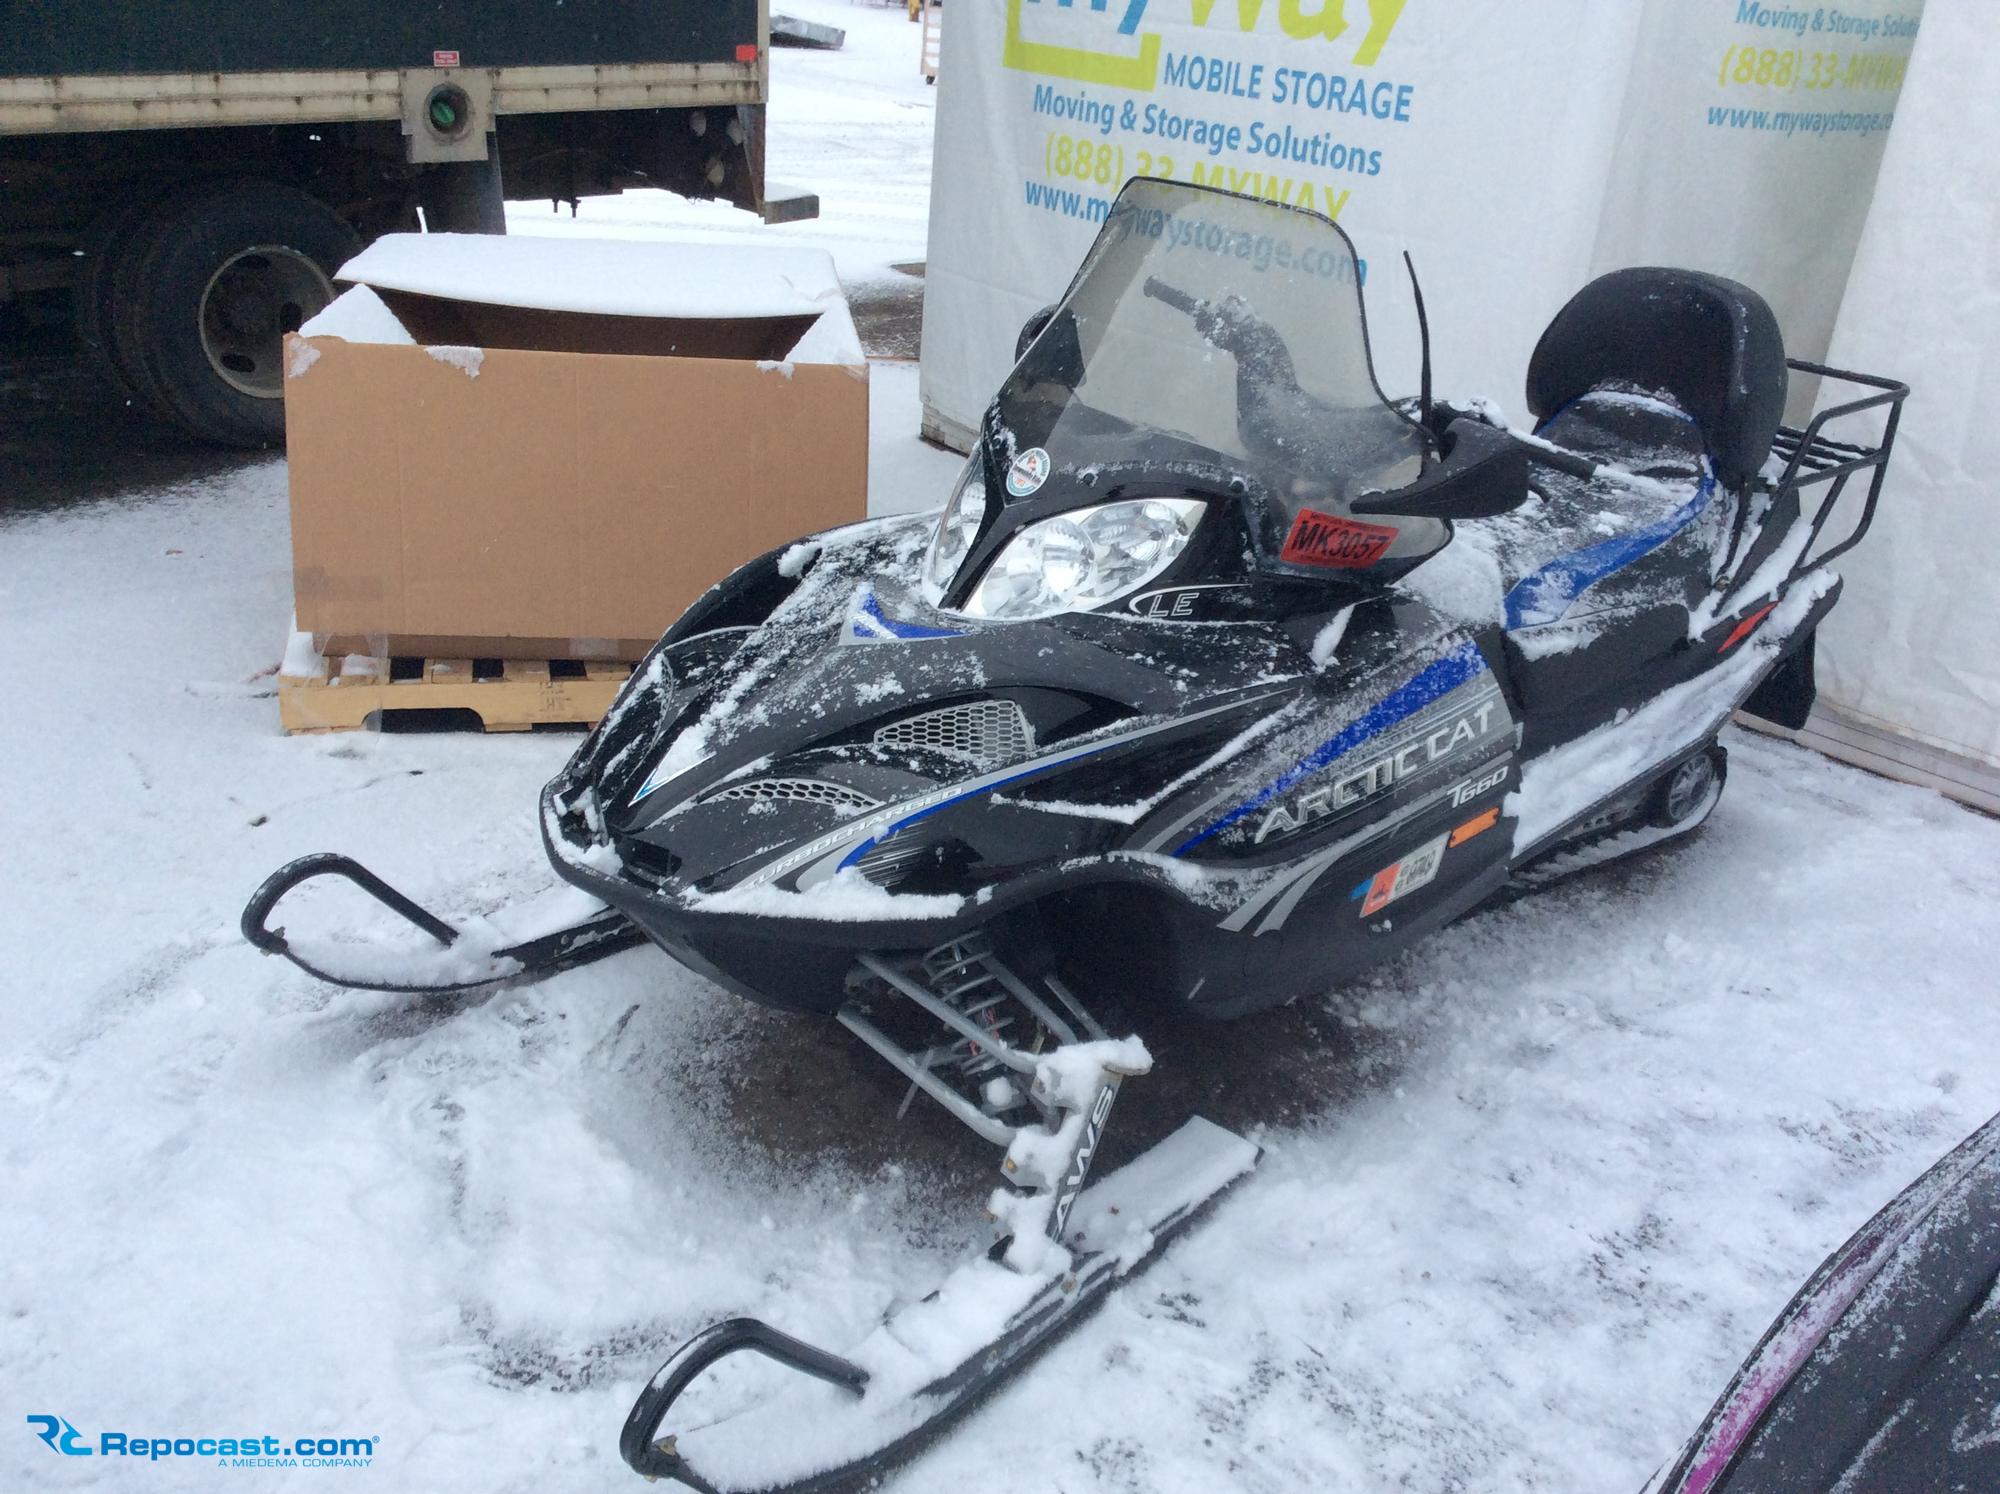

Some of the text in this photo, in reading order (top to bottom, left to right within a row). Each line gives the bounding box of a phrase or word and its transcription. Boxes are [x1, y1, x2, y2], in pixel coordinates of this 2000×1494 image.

[1164, 53, 1414, 122] MOBILE STORAGE
[1033, 85, 1383, 176] Moving & Storage Solutions
[1046, 132, 1124, 193] (888)
[1148, 592, 1200, 617] LE
[1254, 701, 1495, 844] ARCTIC CAT
[1447, 766, 1509, 808] T660
[1056, 1086, 1113, 1234] AWS
